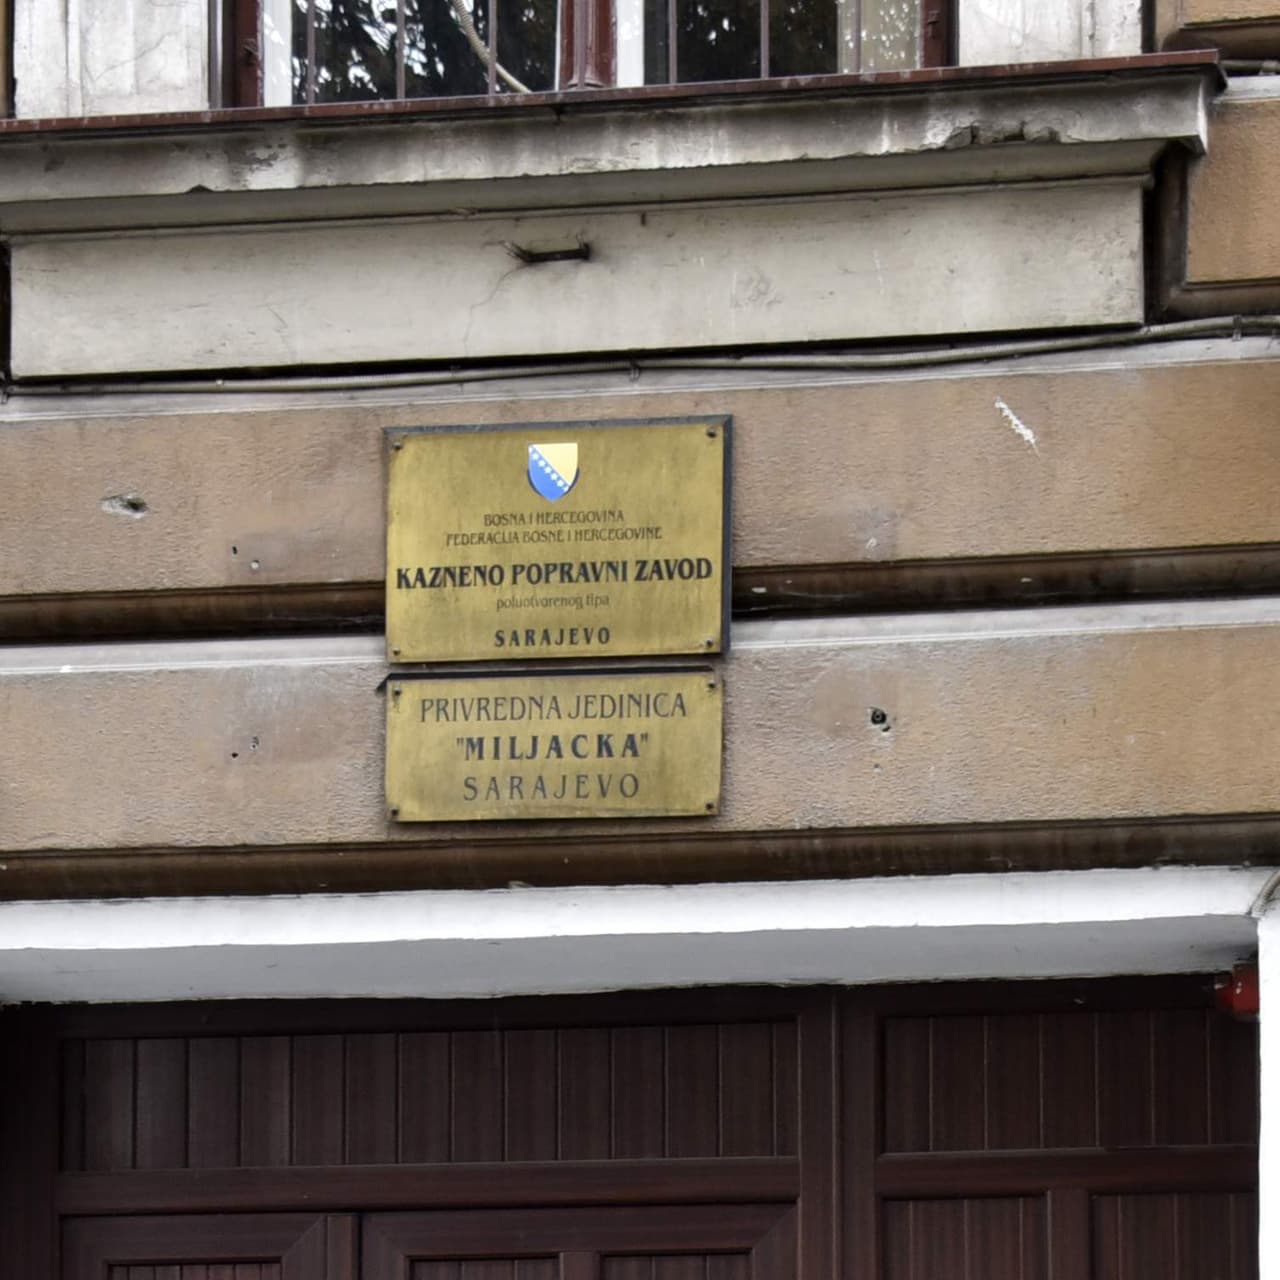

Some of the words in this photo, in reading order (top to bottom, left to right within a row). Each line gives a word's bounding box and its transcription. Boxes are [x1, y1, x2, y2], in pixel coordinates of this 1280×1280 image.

[484, 512, 526, 527] BOSNA
[536, 509, 625, 525] HERCEGOVINA
[446, 531, 519, 547] FEDERACIJA
[522, 529, 564, 544] BOSNE
[575, 526, 663, 542] HERCEGOVINE
[396, 563, 505, 590] KAZNENO
[511, 559, 628, 586] POPRAVNI
[634, 556, 713, 582] ZAVOD
[496, 595, 584, 612] poluotvorenog
[586, 593, 610, 610] tipa
[494, 626, 611, 648] SARAJEVO
[421, 694, 562, 723] PRIVREDNA
[568, 692, 687, 720] JEDINICA
[456, 733, 649, 761] "MILJACKA"
[463, 773, 640, 801] SARAJEVO
